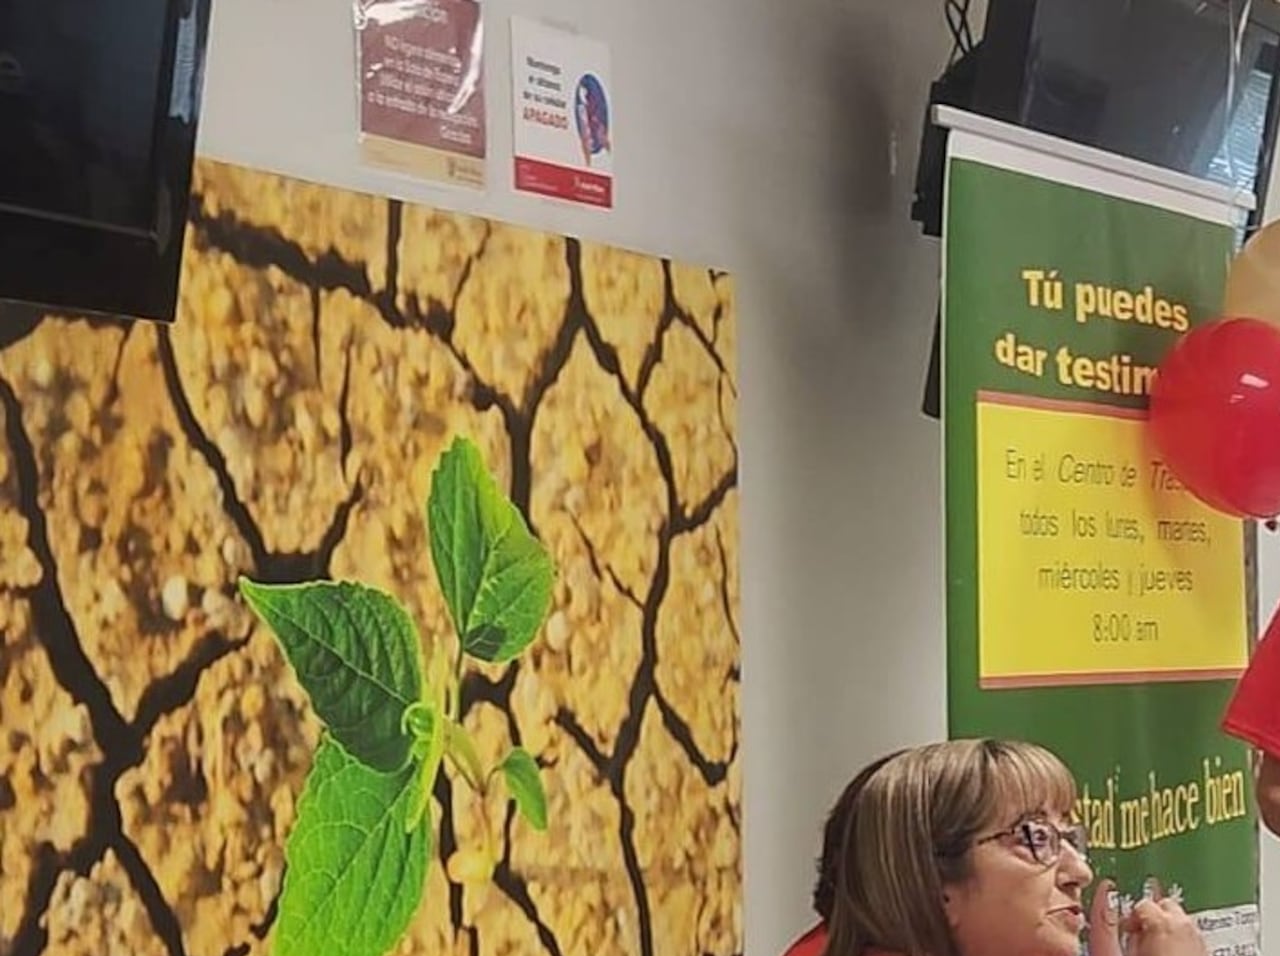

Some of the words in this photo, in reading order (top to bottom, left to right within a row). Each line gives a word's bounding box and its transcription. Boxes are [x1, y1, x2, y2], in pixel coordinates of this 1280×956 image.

[1022, 269, 1063, 310] Tú
[1075, 283, 1190, 332] puedes
[995, 332, 1048, 377] dar
[1006, 448, 1026, 480] En
[1058, 453, 1114, 486] Centro
[1020, 507, 1059, 537] todos
[1072, 508, 1097, 538] los
[1038, 560, 1120, 590] miércoles
[1139, 562, 1194, 597] jueves
[1092, 613, 1131, 643] 8:00
[1136, 620, 1159, 642] am
[1119, 796, 1150, 850] me
[1149, 771, 1200, 840] hace
[1203, 756, 1246, 824] bien
